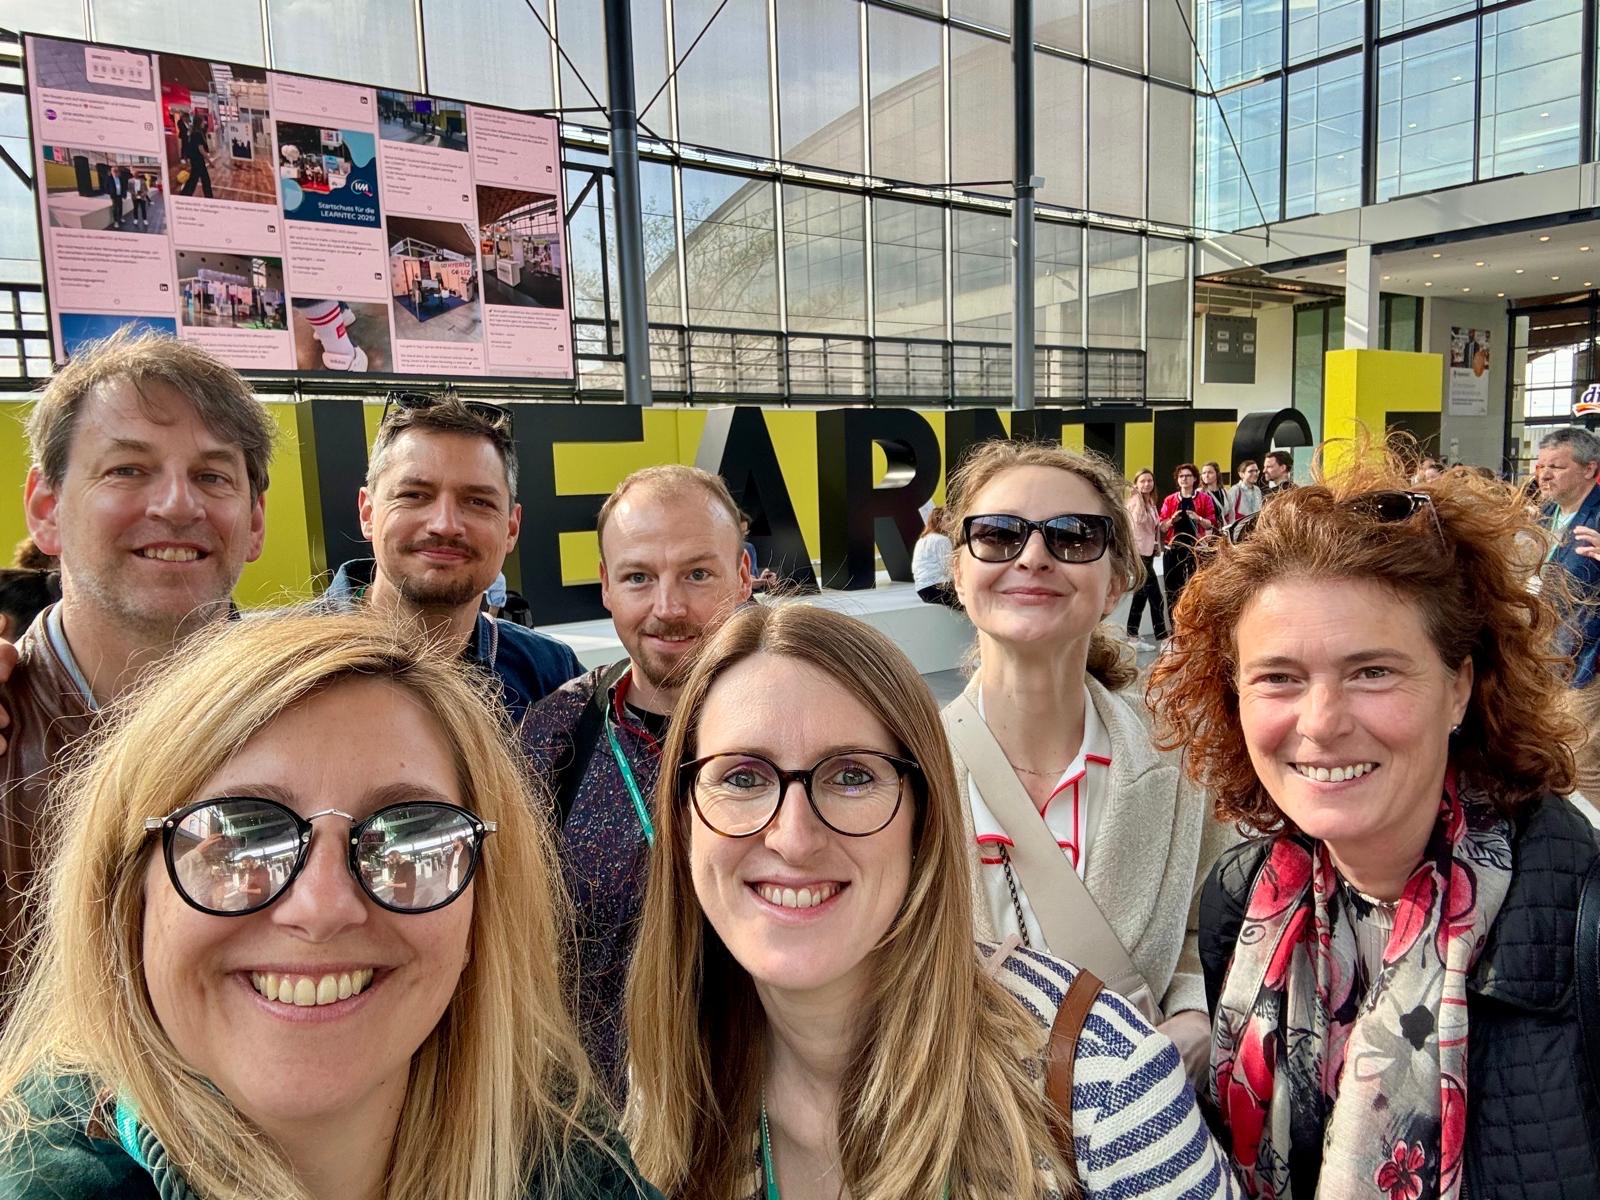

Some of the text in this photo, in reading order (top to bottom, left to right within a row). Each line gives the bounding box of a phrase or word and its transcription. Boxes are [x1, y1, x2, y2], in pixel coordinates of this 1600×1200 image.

[318, 202, 354, 211] Startschuss
[320, 211, 356, 219] LEARNTEC
[1583, 386, 1600, 403] d
[299, 399, 1312, 624] LEARTEC
